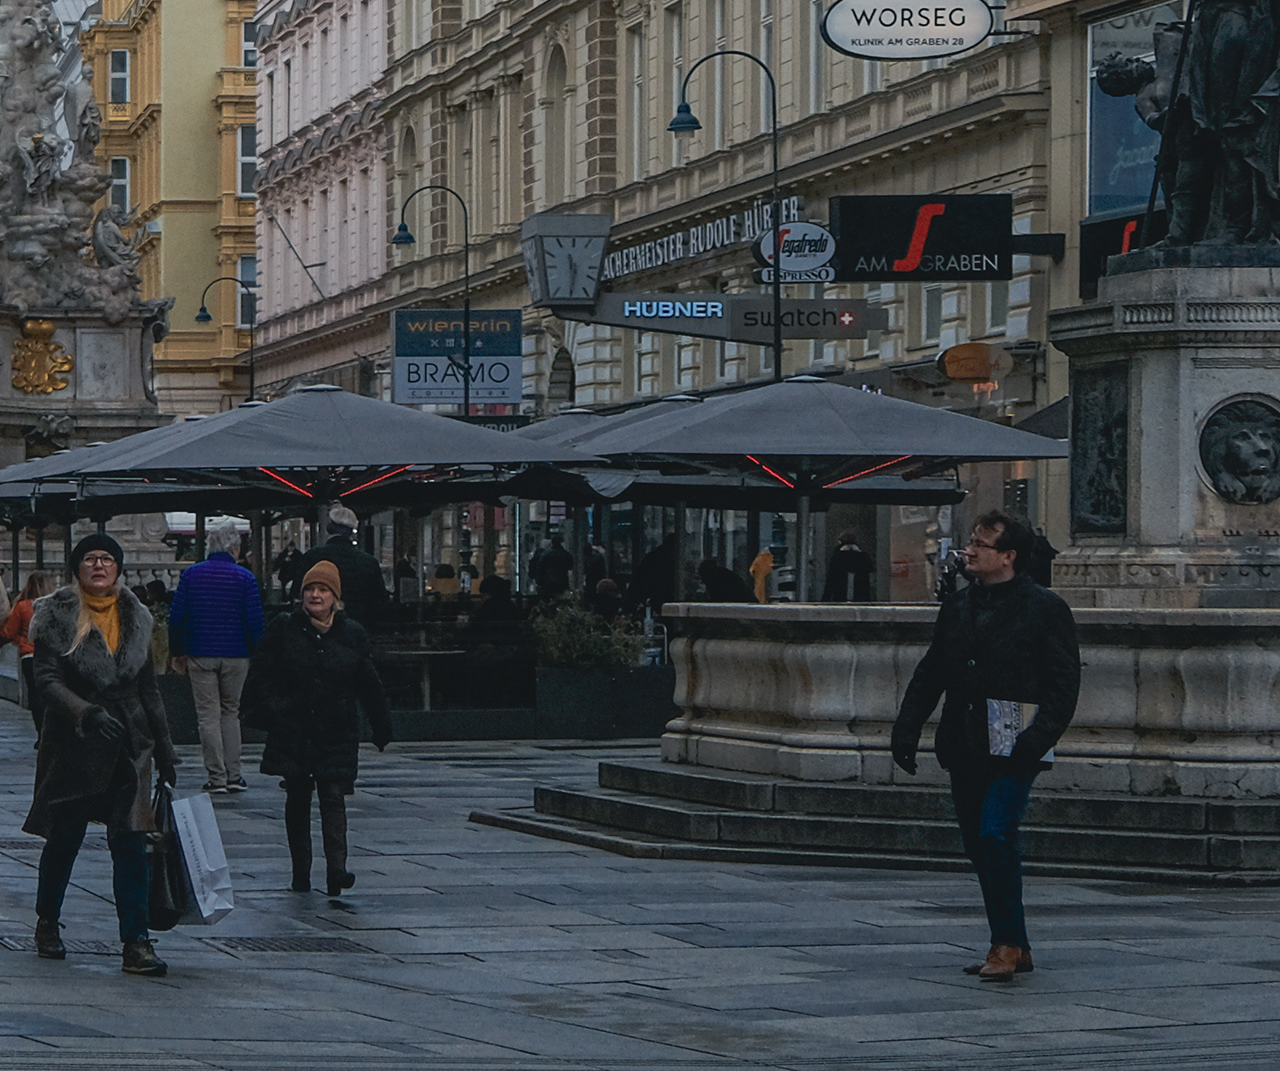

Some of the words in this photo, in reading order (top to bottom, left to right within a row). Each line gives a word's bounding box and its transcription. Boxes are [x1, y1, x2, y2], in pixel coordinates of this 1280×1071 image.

[851, 7, 966, 27] WORSEG
[851, 38, 884, 47] KLINIK
[887, 37, 904, 46] AM
[907, 37, 950, 47] GRABEN
[952, 37, 964, 46] 28
[689, 214, 738, 258] RUDOLF
[741, 195, 800, 242] HÜBER
[854, 255, 888, 272] AM
[919, 253, 999, 272] GRABEN
[623, 301, 724, 319] HÜBNER
[743, 307, 837, 328] swatch
[407, 318, 512, 332] wienerin
[407, 362, 510, 384] BRAMO
